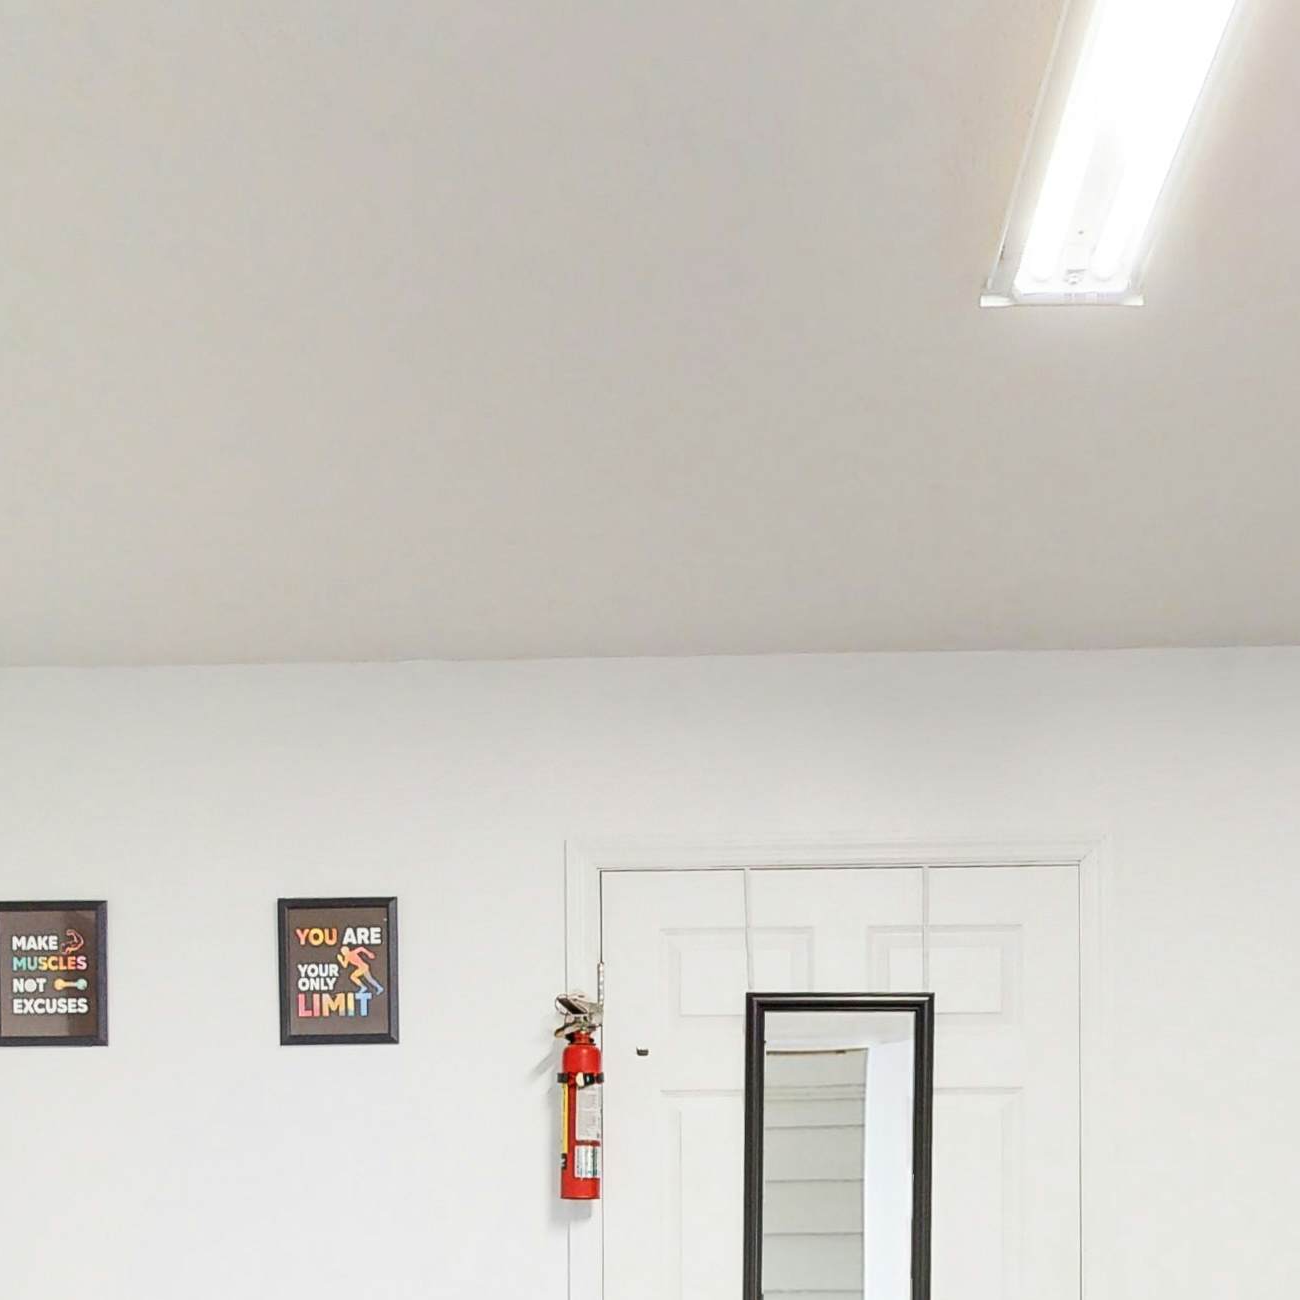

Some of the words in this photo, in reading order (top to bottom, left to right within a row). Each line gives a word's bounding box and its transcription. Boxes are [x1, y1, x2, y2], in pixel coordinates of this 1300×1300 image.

[12, 935, 58, 951] MAKE
[295, 927, 338, 946] YOU
[342, 927, 382, 945] ARE
[12, 956, 88, 971] MUSCLES
[297, 963, 339, 978] YOUR
[12, 978, 47, 993] NOT
[297, 977, 337, 991] ONLY
[12, 998, 89, 1014] EXCUSES
[297, 992, 373, 1017] LIMIT
